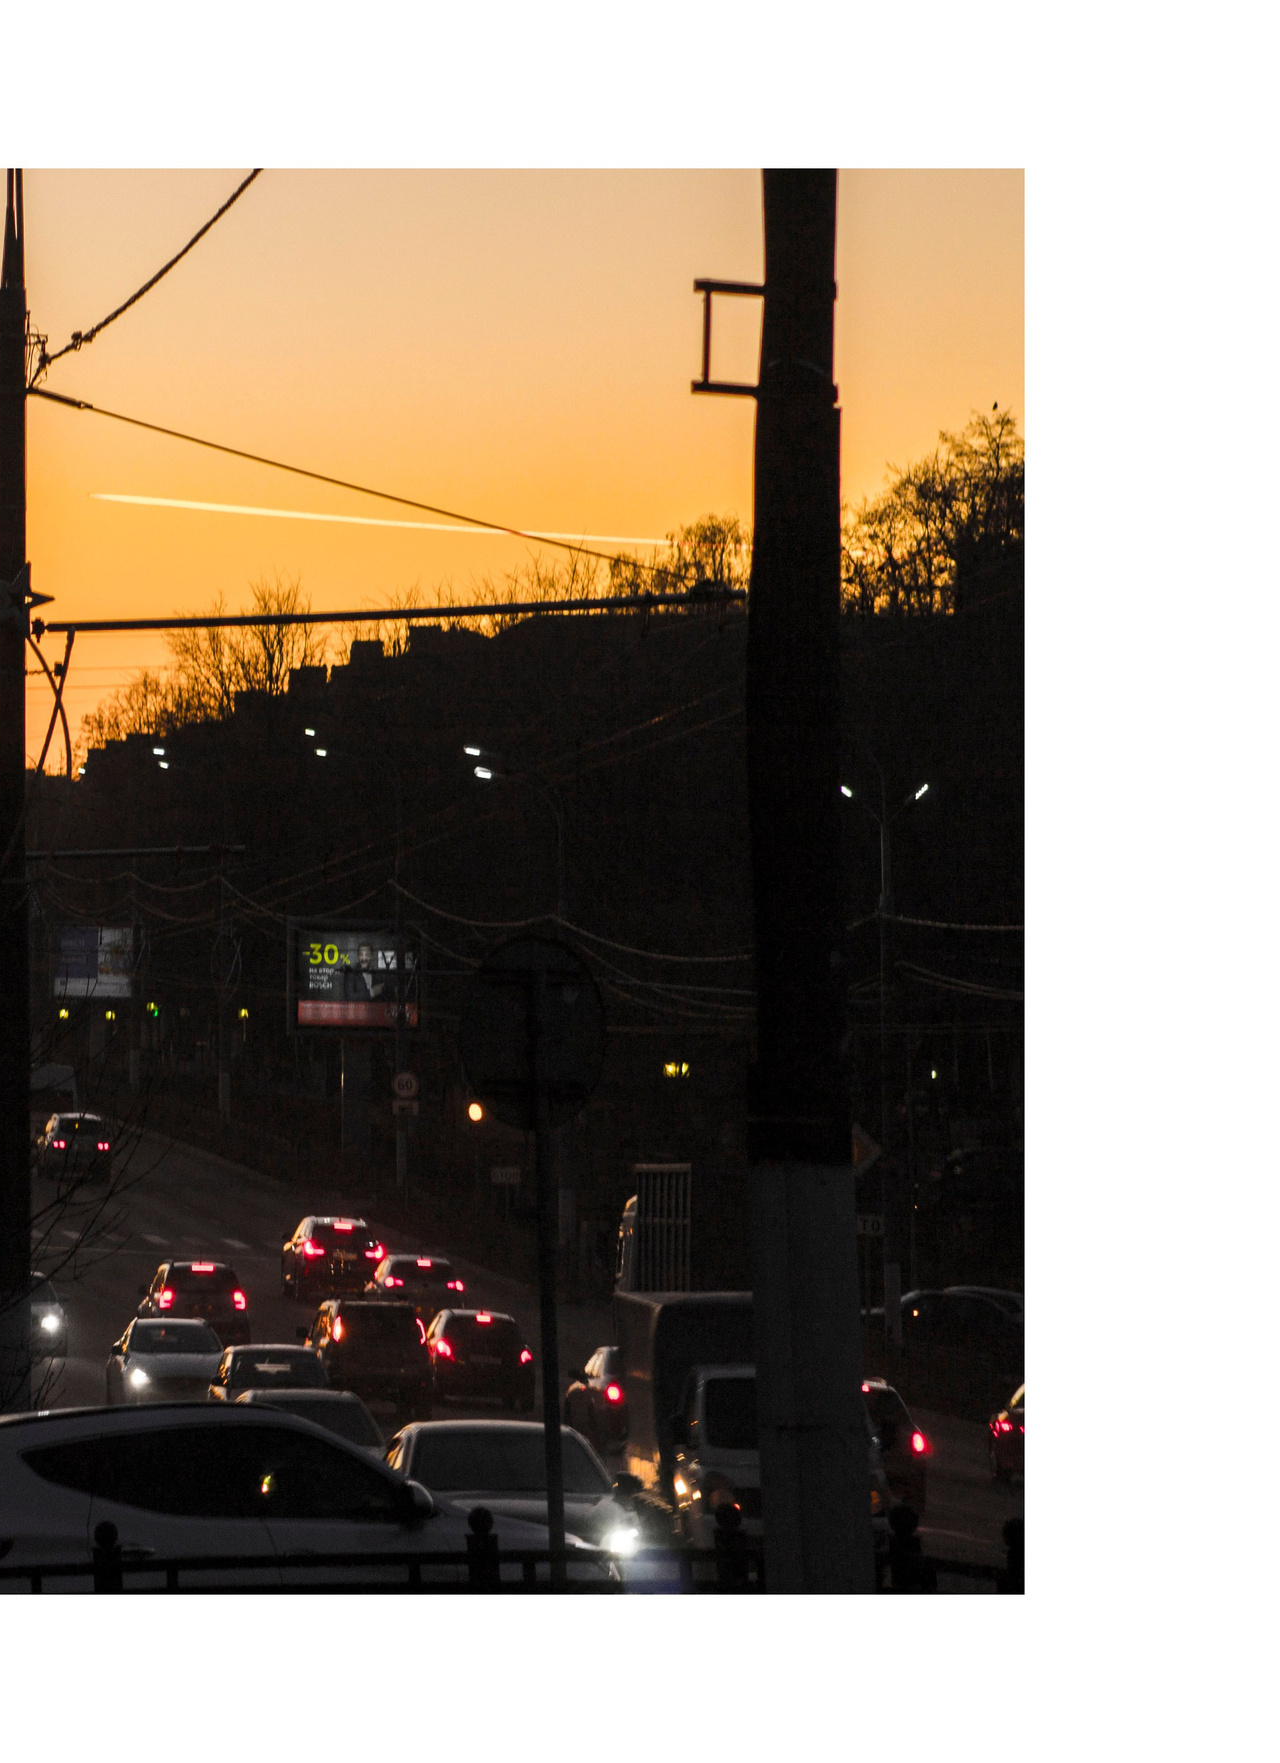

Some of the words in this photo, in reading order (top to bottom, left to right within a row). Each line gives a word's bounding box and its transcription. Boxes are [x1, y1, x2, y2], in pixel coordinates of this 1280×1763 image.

[302, 943, 351, 965] -30%
[309, 981, 333, 990] BOSCH
[397, 1078, 413, 1091] 60
